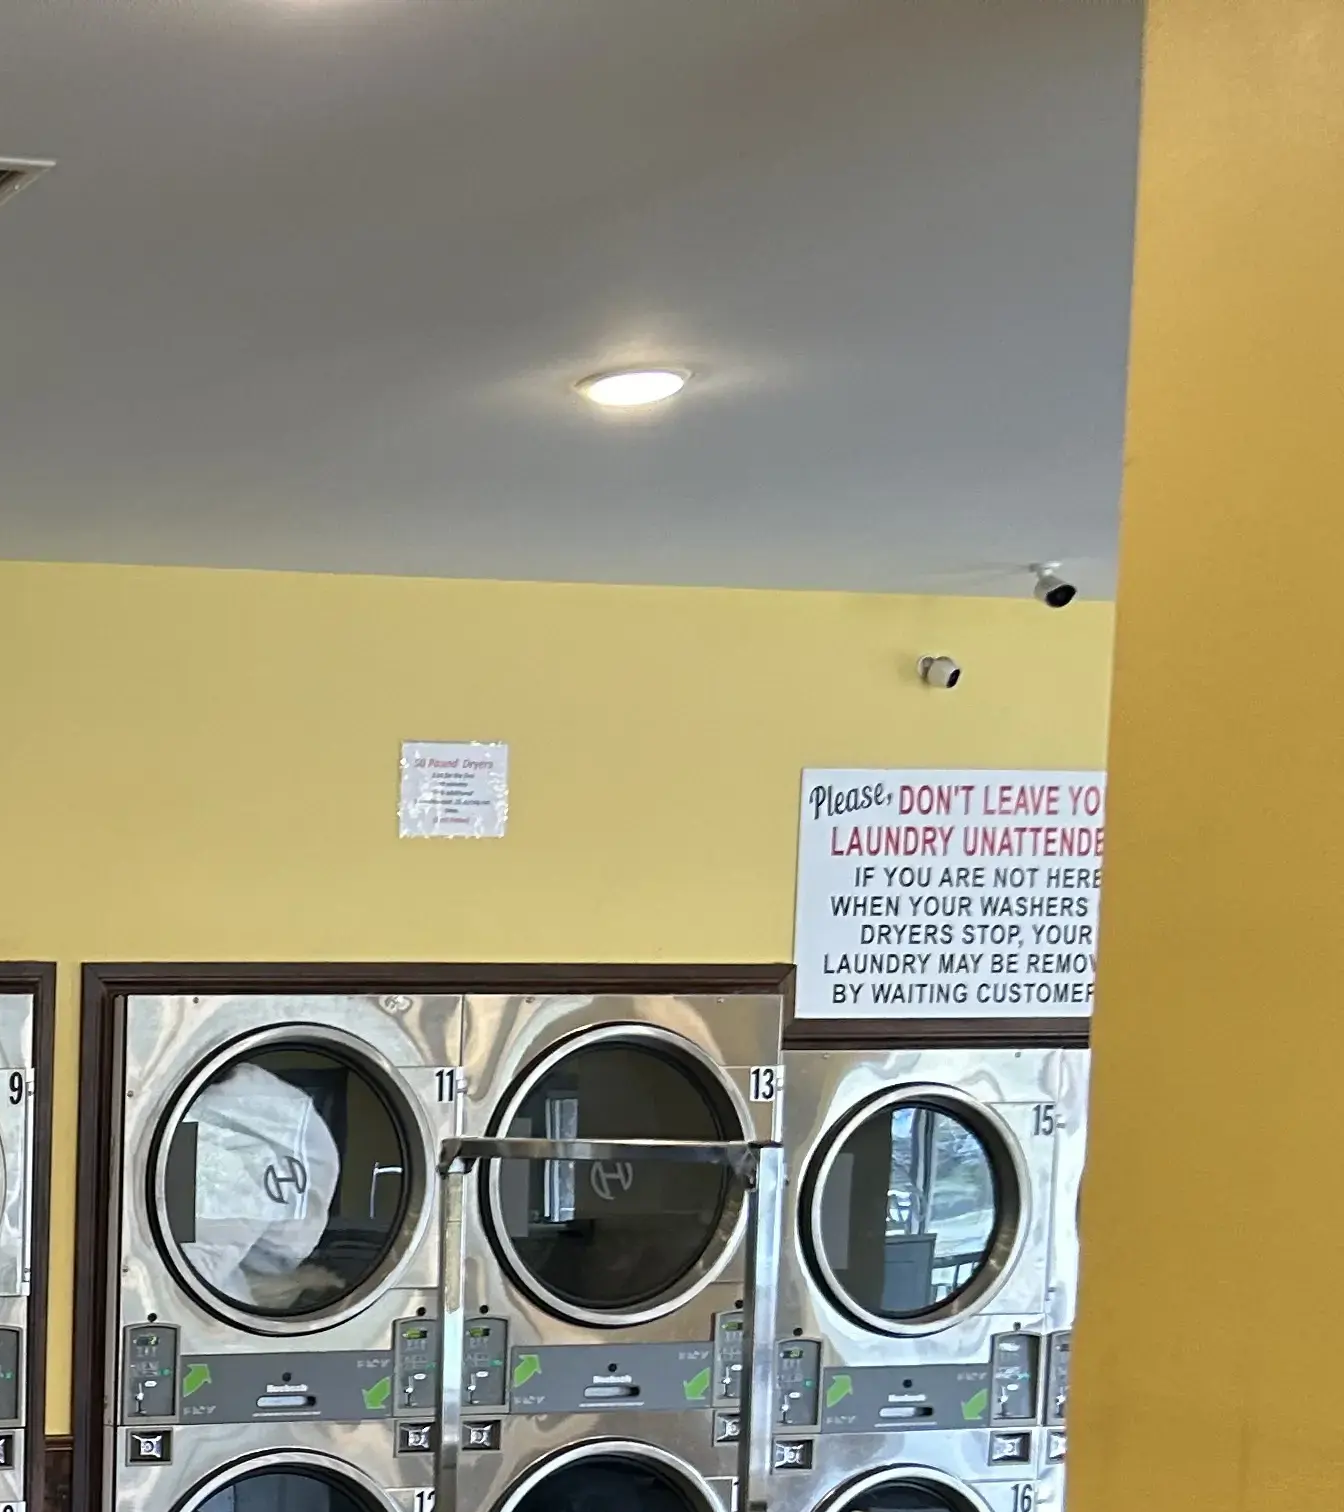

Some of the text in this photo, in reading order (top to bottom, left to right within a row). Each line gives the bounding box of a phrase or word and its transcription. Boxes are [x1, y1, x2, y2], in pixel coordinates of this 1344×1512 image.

[810, 782, 892, 819] Please,
[899, 785, 974, 815] DON'T
[983, 786, 1060, 816] LEAVE
[831, 826, 954, 857] LAUNDRY
[855, 867, 1101, 889] IF YOU ARE NOT HERE
[831, 896, 1088, 917] WHEN YOUR WASHERS
[861, 924, 1092, 948] DRYERS STOP, YOUR
[824, 954, 931, 974] LAUNDRY
[938, 954, 981, 974] MAY
[991, 954, 1018, 973] BE
[833, 984, 864, 1004] BY
[871, 984, 968, 1004] WAITING
[9, 1071, 23, 1105] 9
[435, 1068, 455, 1102] 11
[751, 1068, 774, 1100] 13
[1032, 1104, 1055, 1136] 15
